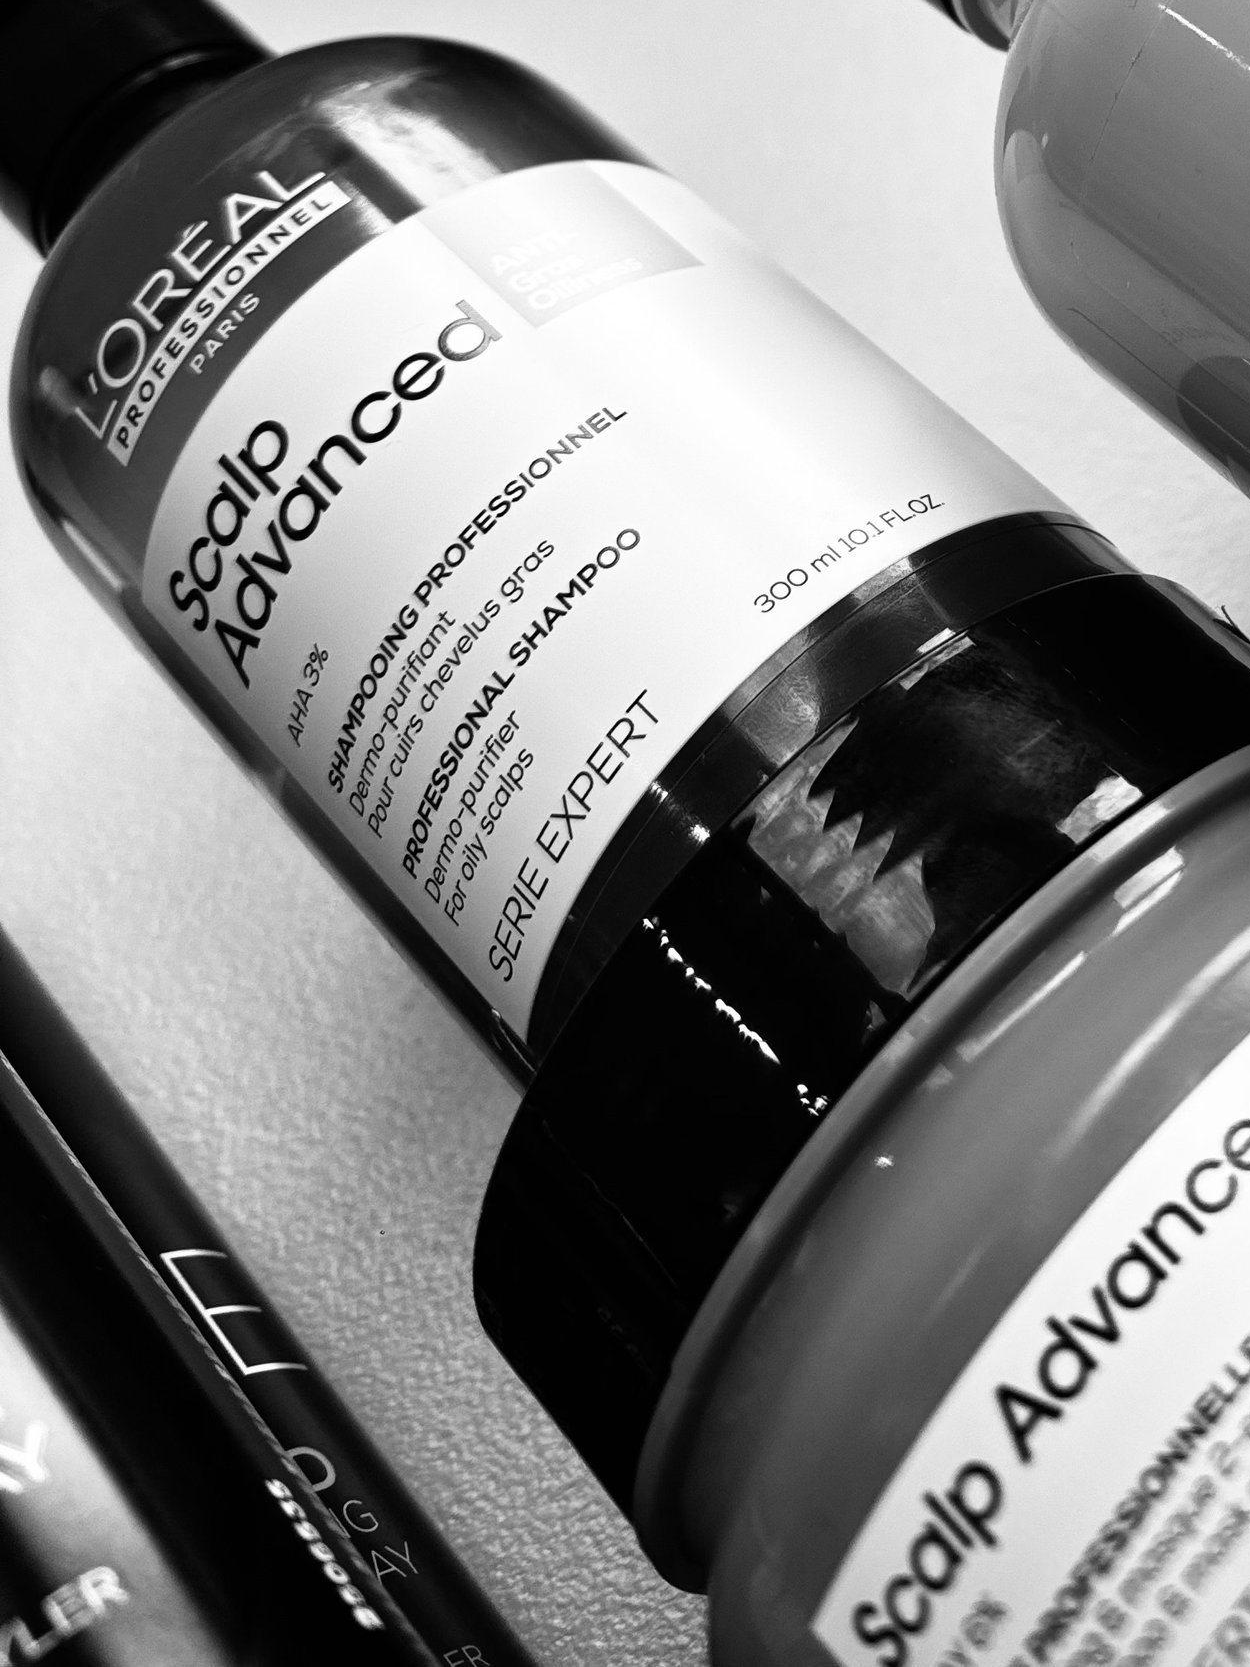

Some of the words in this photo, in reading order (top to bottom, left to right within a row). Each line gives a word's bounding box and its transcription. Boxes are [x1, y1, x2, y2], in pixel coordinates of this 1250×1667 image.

[75, 170, 327, 440] L'ORÉAL
[116, 197, 334, 450] PROFESSIONNEL
[188, 292, 261, 375] PARIS
[168, 419, 291, 634] Scalp
[213, 299, 504, 690] Advanced
[328, 604, 420, 794] SHAMPOOING
[414, 407, 628, 607] PROFESSIONNEL
[753, 567, 809, 614] 300
[809, 544, 842, 574] ml
[287, 687, 314, 748] AHA
[303, 642, 329, 688] 3%
[349, 610, 458, 817] Dermo-purifiant
[367, 776, 394, 838] Pour
[389, 714, 424, 778] cuirs
[420, 599, 501, 713] chevelus
[500, 539, 555, 604] gras
[402, 671, 516, 880] PROFESSIONAL
[508, 528, 641, 667] SHAMPOO
[425, 709, 520, 904] Dermo-purifier
[443, 879, 468, 927] For
[461, 832, 489, 882] oily
[480, 748, 535, 837] scalps
[488, 857, 550, 982] SERIE
[536, 688, 659, 864] EXPERT
[852, 1459, 1005, 1667] Scalp
